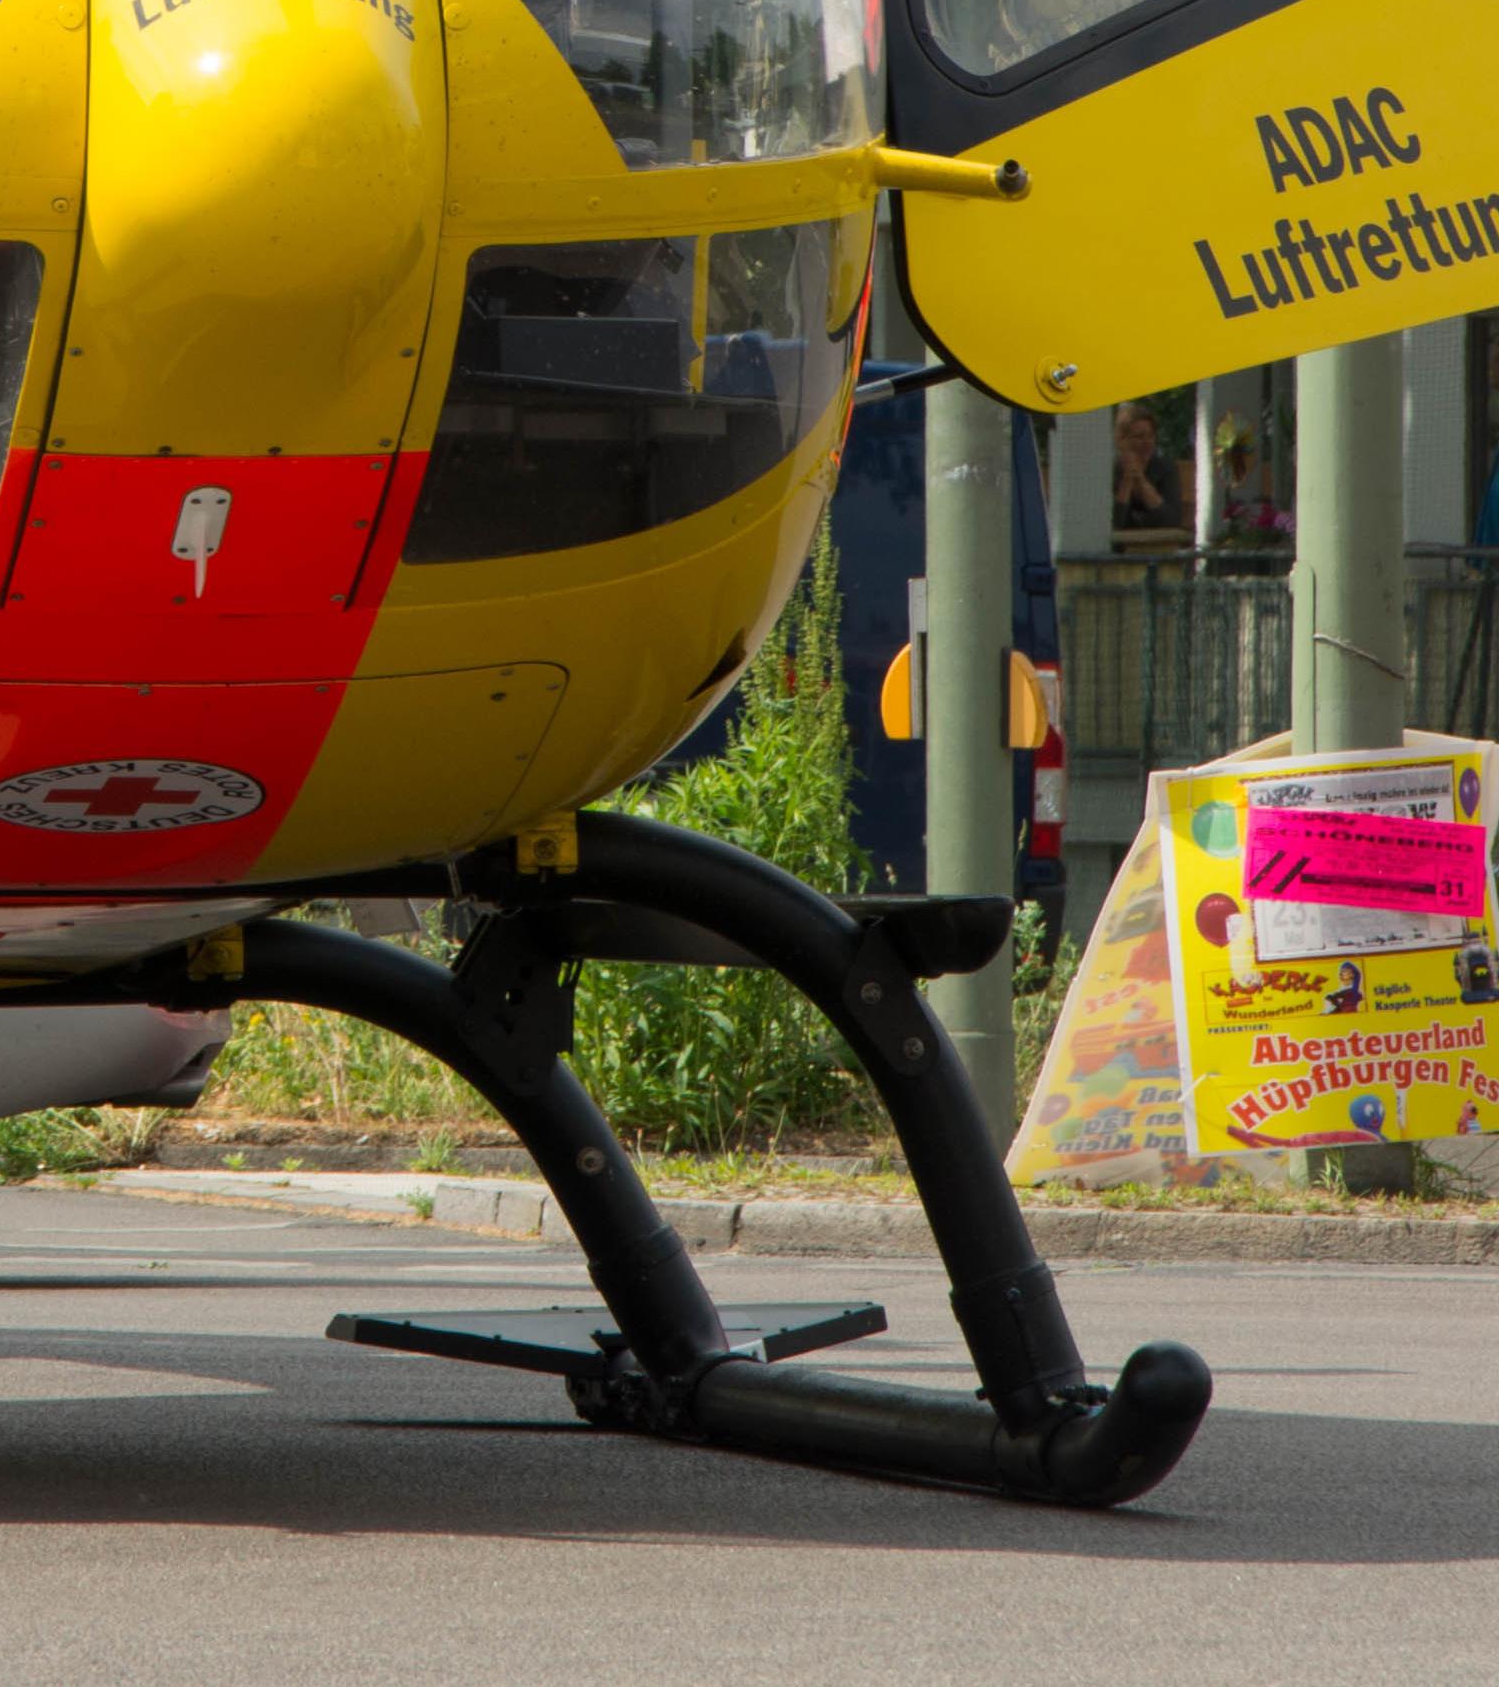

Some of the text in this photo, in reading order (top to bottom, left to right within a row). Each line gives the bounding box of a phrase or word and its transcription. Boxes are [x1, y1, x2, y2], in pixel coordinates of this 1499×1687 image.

[1254, 86, 1422, 194] ADAC
[156, 762, 256, 800] ROTES
[1374, 982, 1411, 997] täglich
[1374, 993, 1457, 1012] Kasperle Theater
[1222, 999, 1315, 1021] Wunderland
[1252, 1018, 1486, 1064] Abenteuerland
[1229, 1059, 1449, 1131] Hüpfburgen
